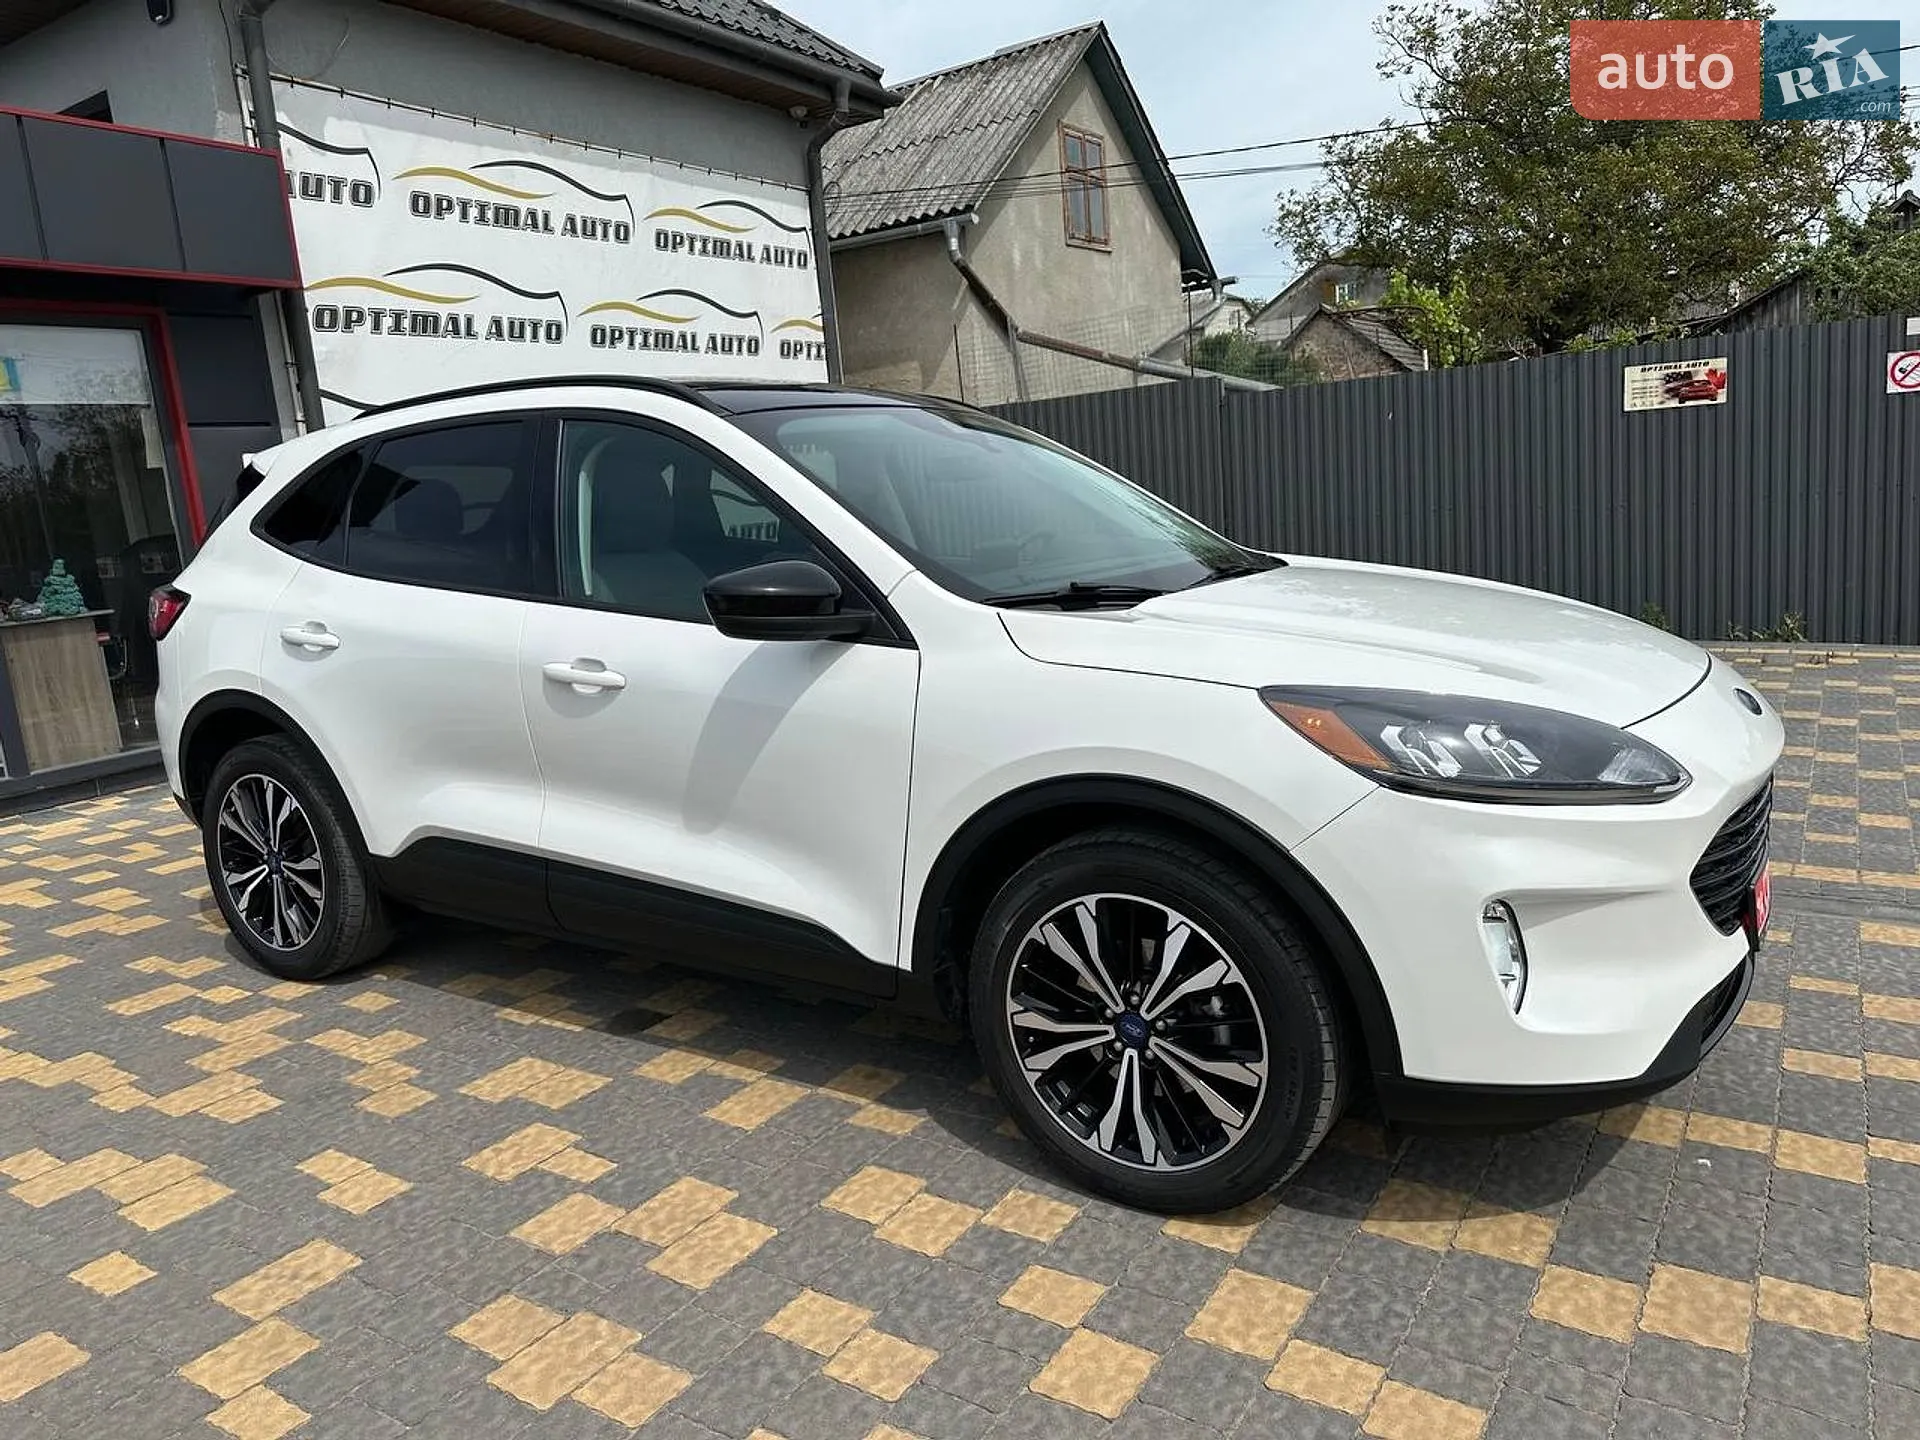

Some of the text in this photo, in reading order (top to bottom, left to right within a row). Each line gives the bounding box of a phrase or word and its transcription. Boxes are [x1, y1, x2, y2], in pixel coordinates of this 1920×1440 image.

[409, 190, 631, 244] OPTIMAL AUTO
[655, 228, 809, 270] OPTIMAL AUTO
[312, 304, 564, 344] OPTIMAL AUTO
[590, 324, 761, 357] OPTIMAL AUTO
